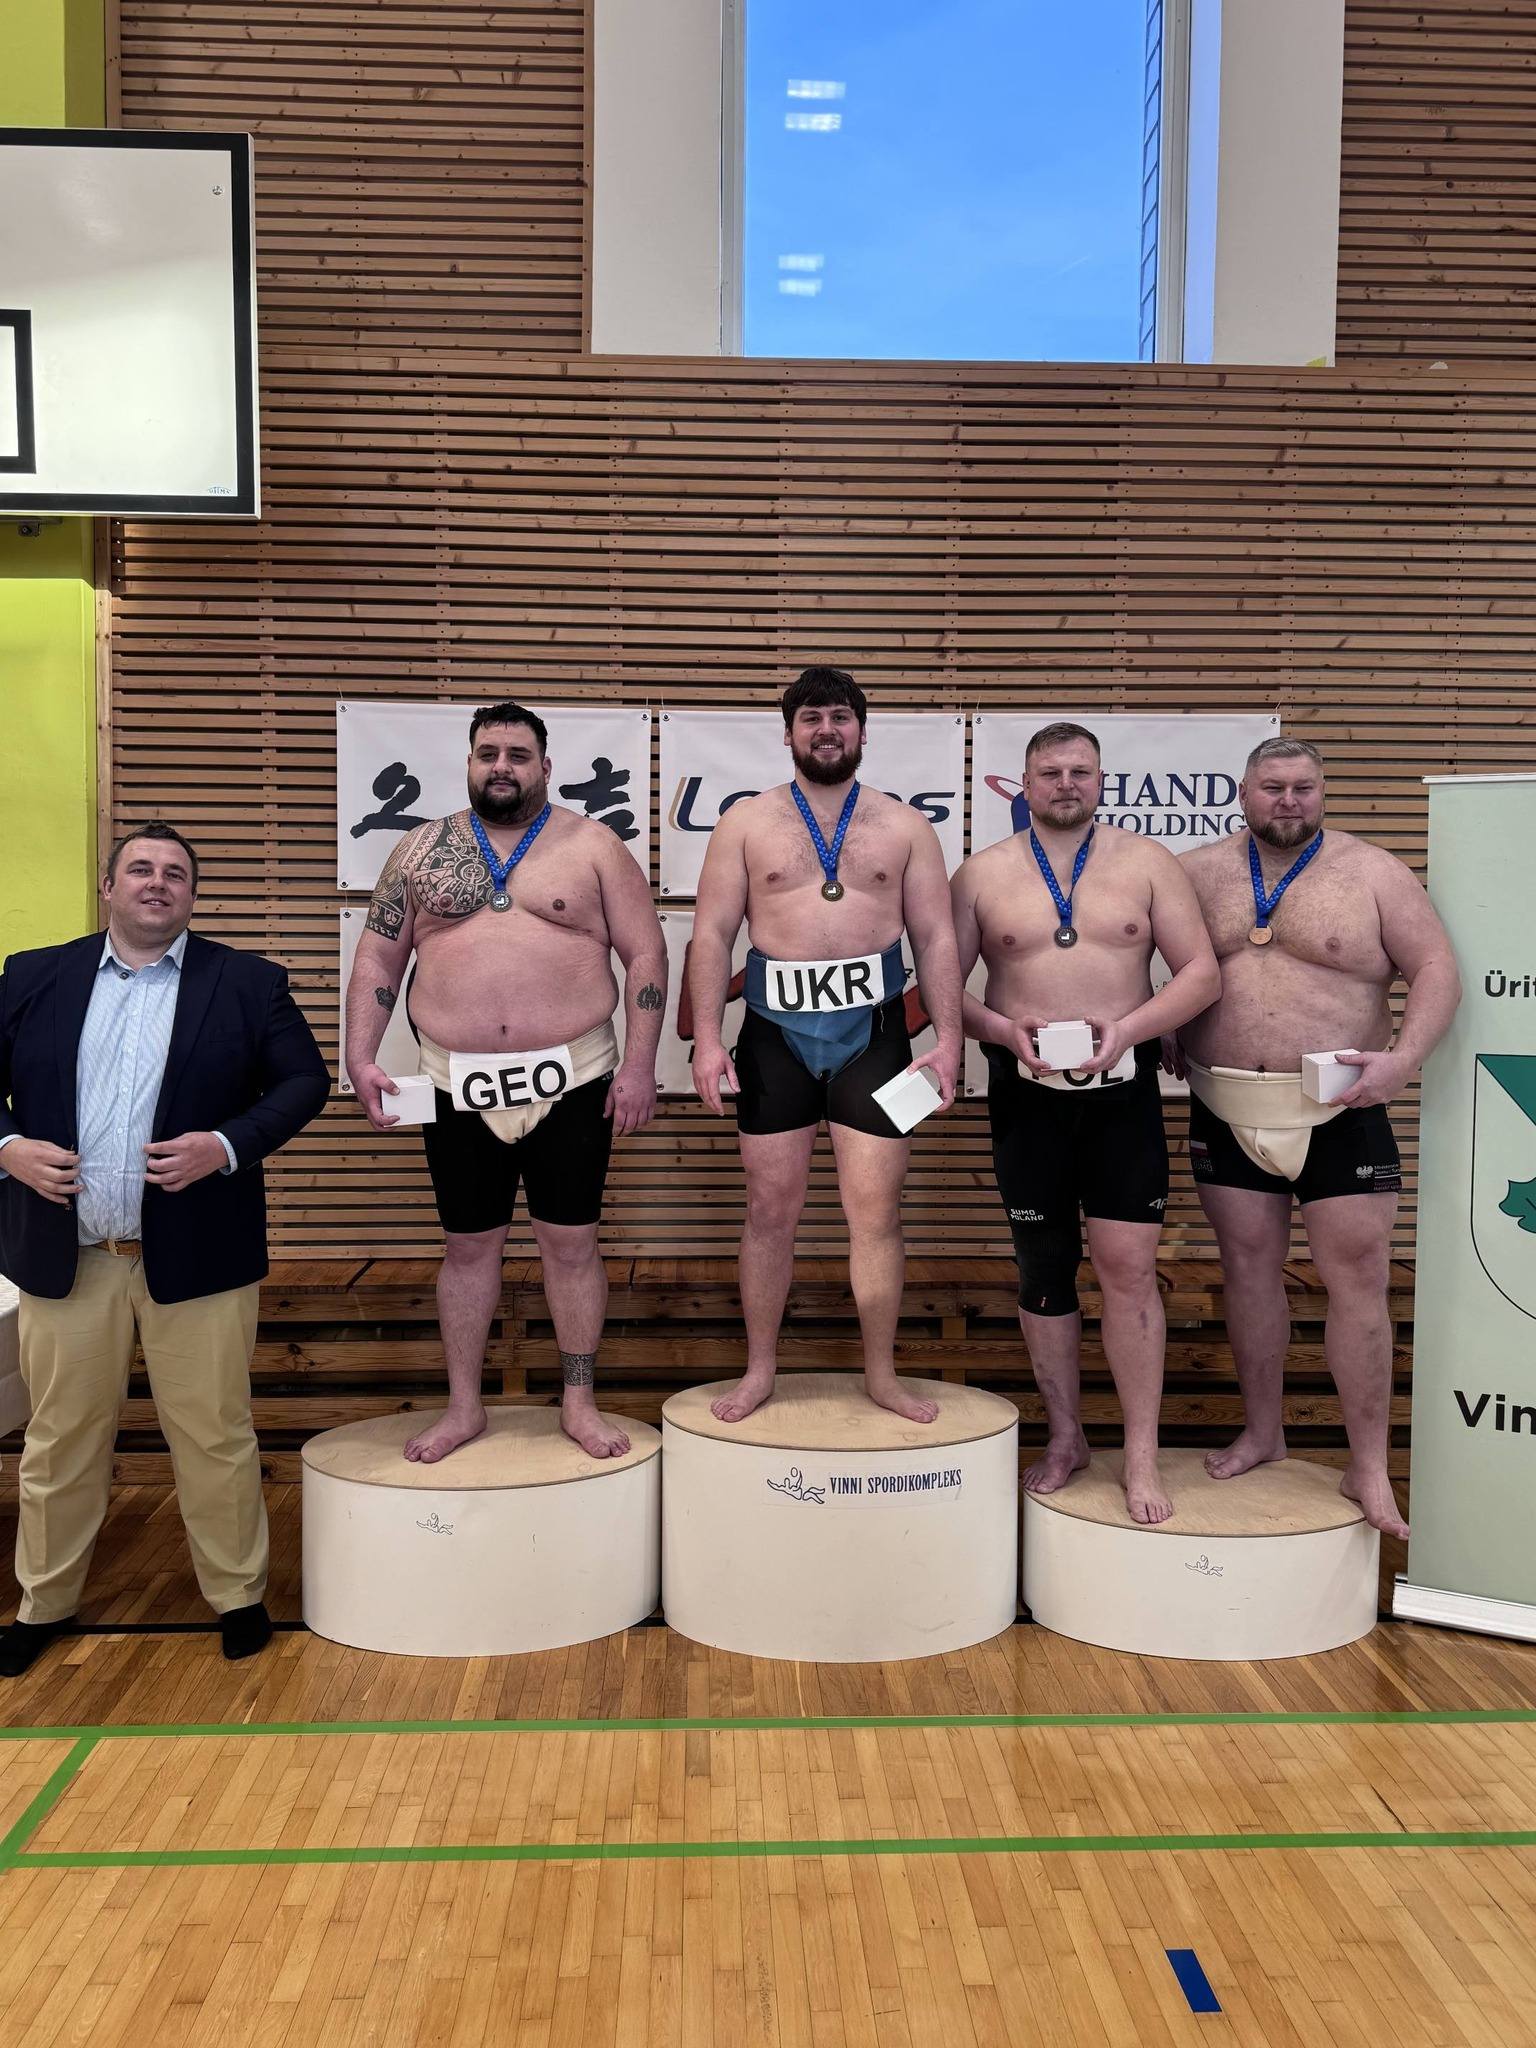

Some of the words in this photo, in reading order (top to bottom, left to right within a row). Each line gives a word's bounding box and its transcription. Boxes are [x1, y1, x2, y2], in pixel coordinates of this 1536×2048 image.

[776, 961, 875, 1011] UKR
[462, 1060, 567, 1111] GEO
[830, 1477, 862, 1494] VINNI
[868, 1469, 962, 1494] SPORDIKOMPLEKS
